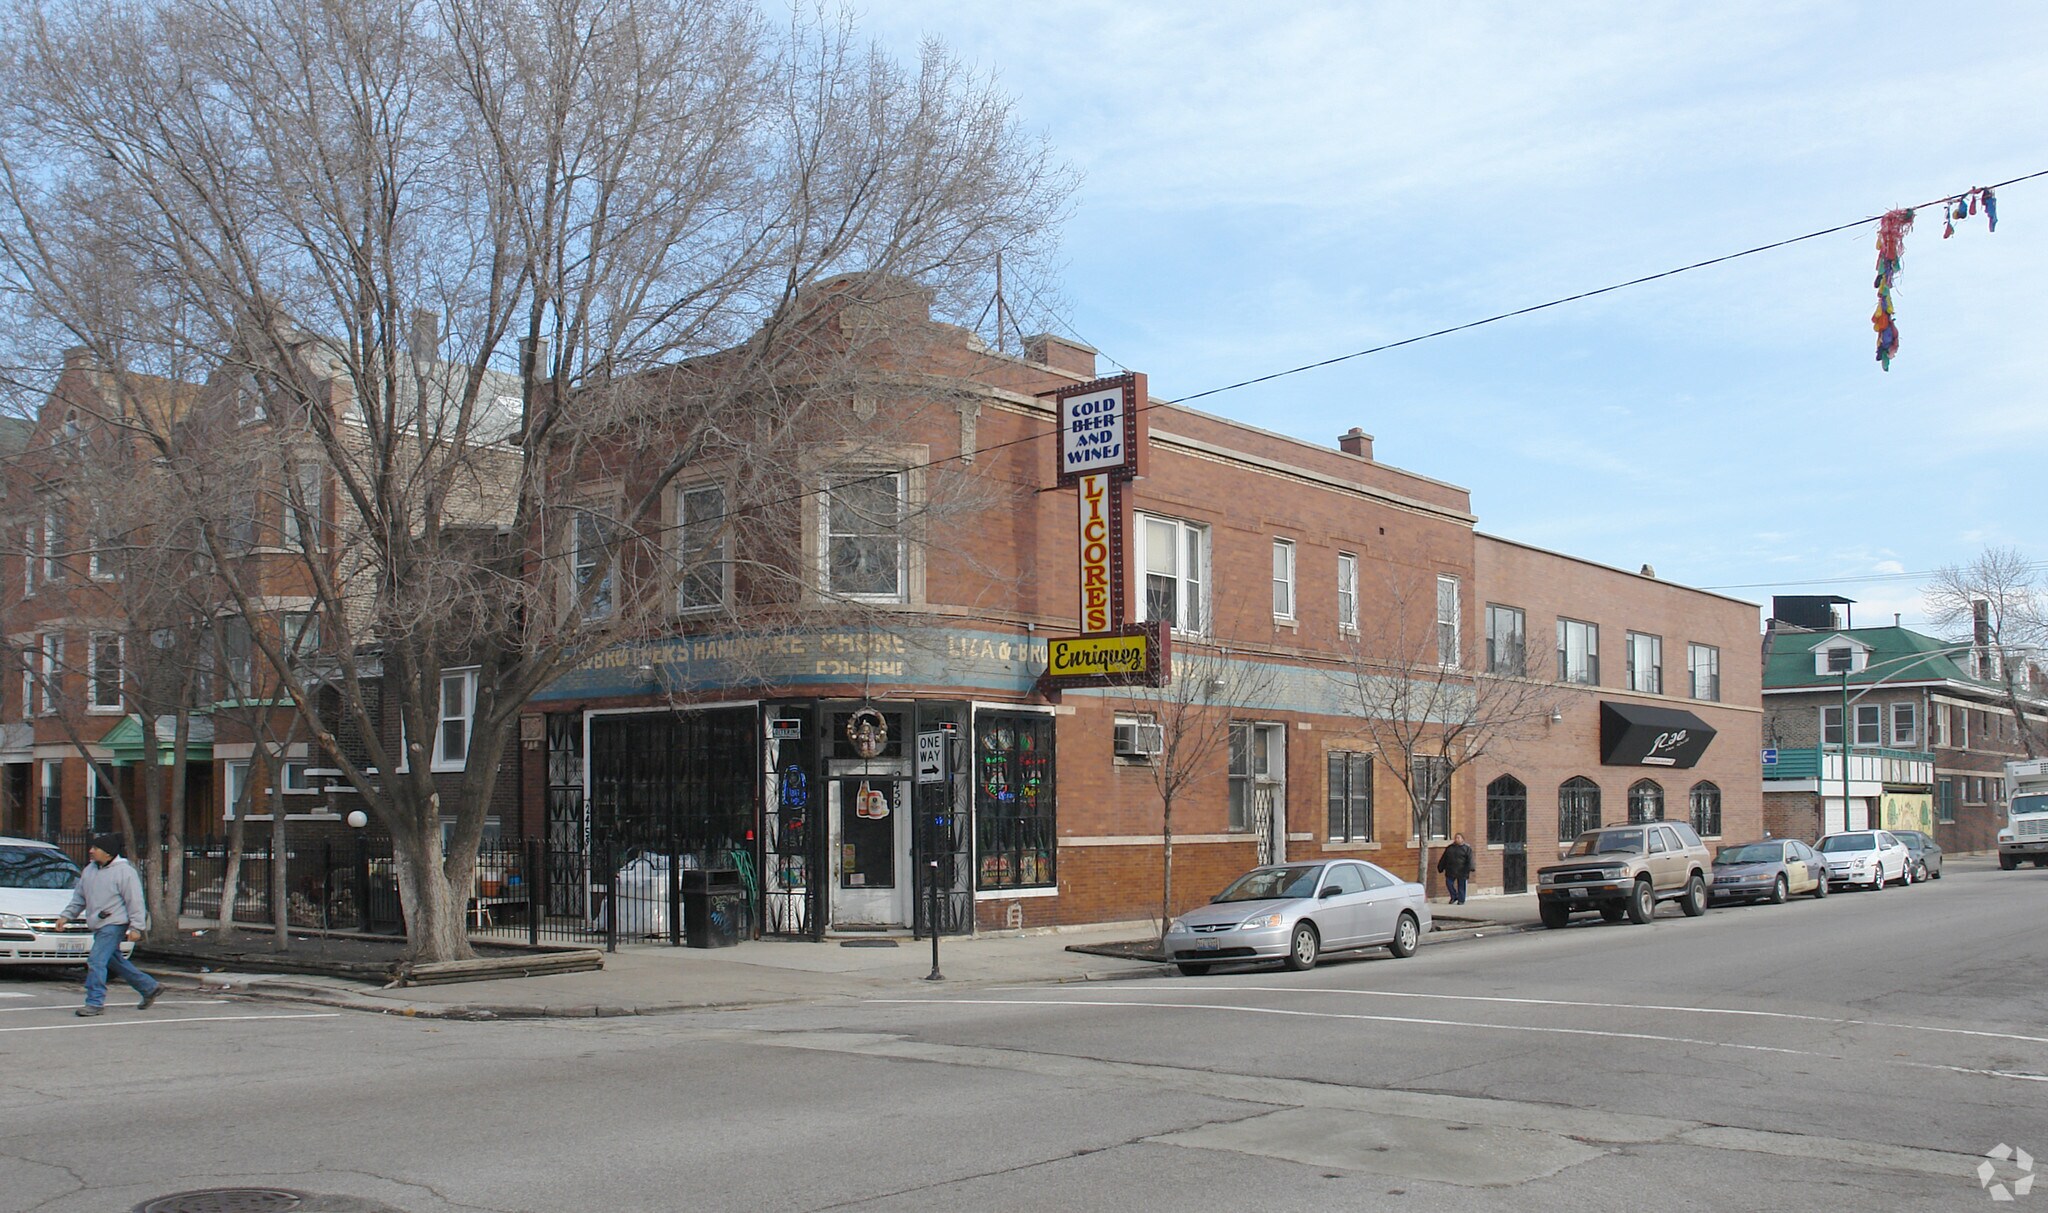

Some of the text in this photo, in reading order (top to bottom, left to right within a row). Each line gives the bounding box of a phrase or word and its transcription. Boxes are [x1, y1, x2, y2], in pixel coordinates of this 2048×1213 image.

[1072, 398, 1116, 417] COLD
[1072, 414, 1115, 433] BEER
[1076, 430, 1113, 448] AND
[1067, 443, 1121, 464] WINES
[1084, 476, 1108, 631] LICORES
[999, 641, 1012, 661] &
[1055, 643, 1142, 671] Enriquez
[920, 736, 940, 749] ONE
[920, 750, 940, 763] WAY
